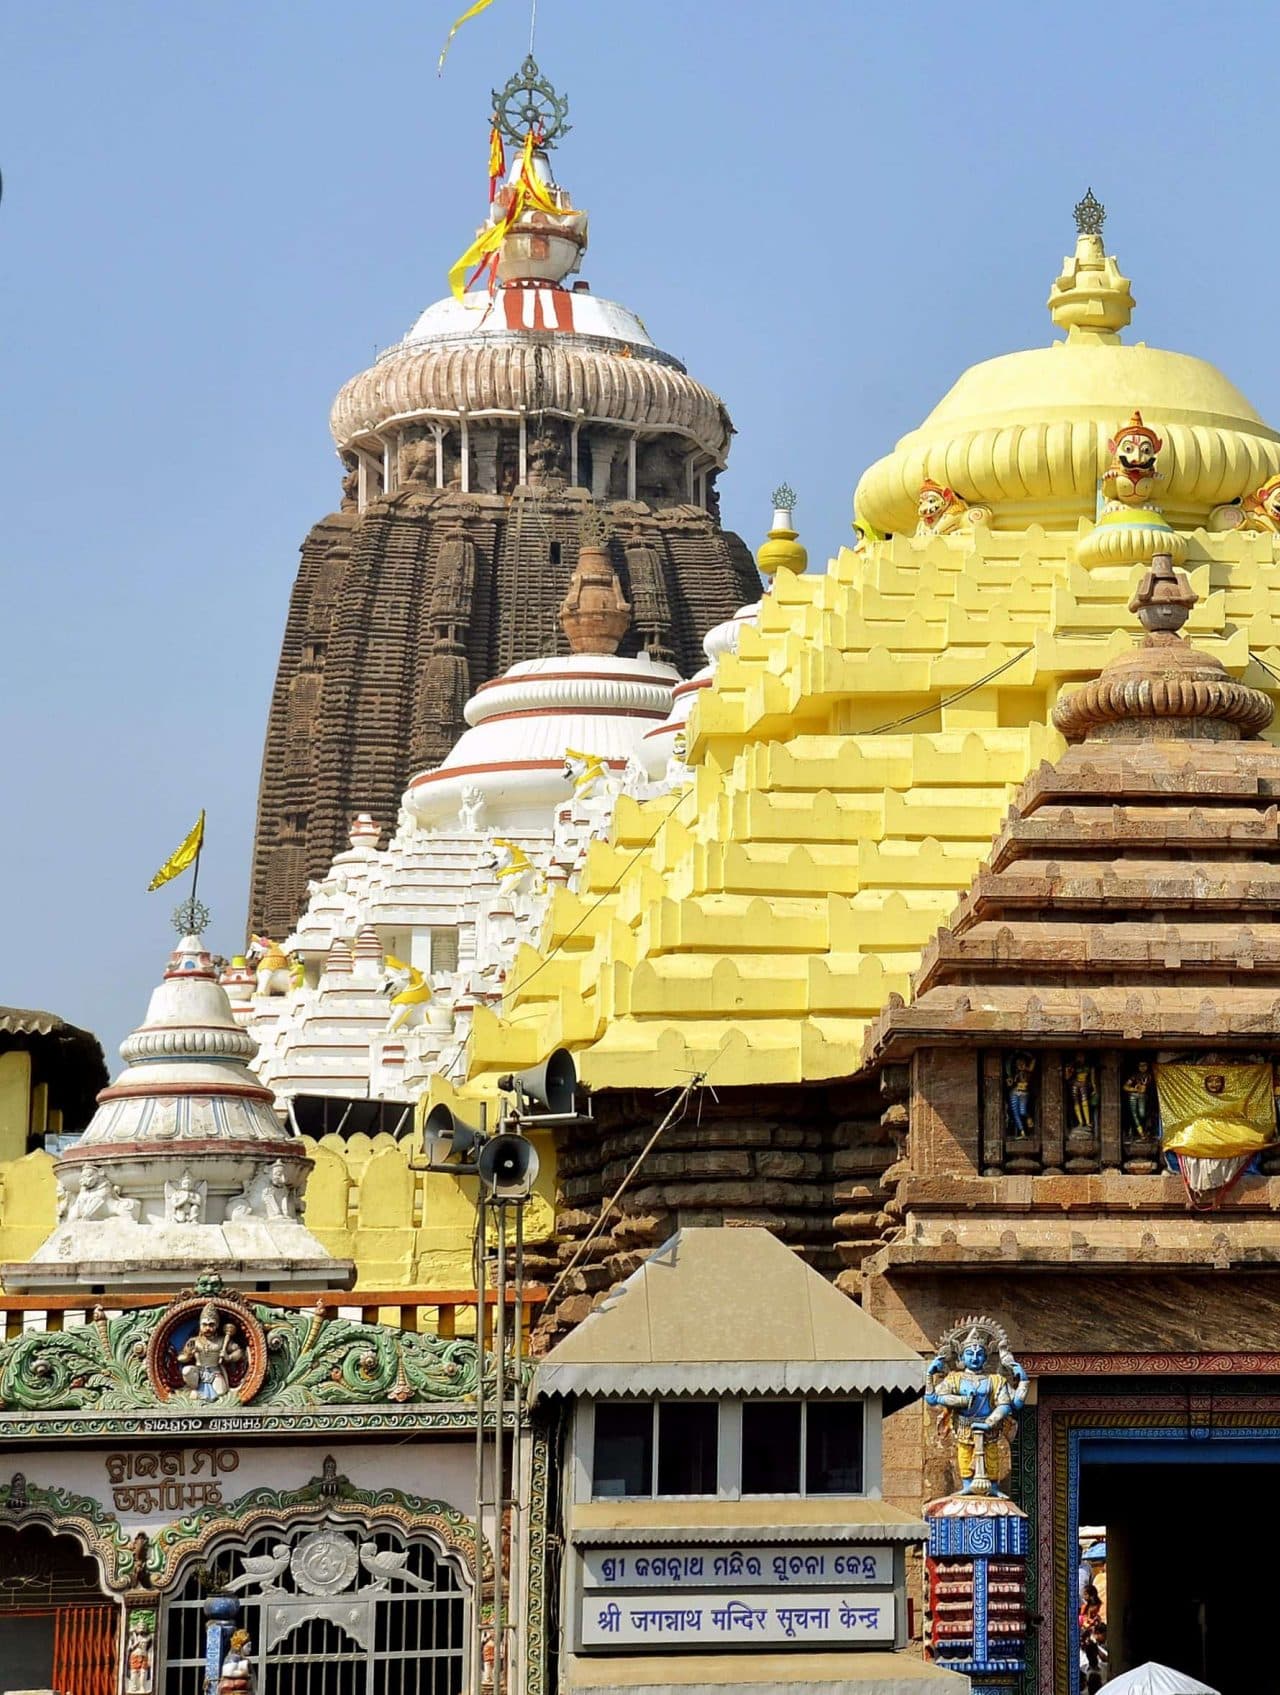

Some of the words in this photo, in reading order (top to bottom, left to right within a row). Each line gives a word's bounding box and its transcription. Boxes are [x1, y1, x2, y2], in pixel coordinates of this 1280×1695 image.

[601, 1557, 625, 1581] ଶ୍ରୀ
[635, 1556, 703, 1581] ଜଗନ୍ନାଥ
[713, 1551, 762, 1577] ମନ୍ଦିର
[772, 1555, 824, 1581] ସୂଚନା
[834, 1555, 877, 1580] କେନ୍ଦ୍ର
[598, 1602, 622, 1633] श्री
[630, 1609, 703, 1632] जगन्नाथ
[711, 1600, 768, 1631] मन्दिर
[776, 1608, 831, 1638] सूचना
[839, 1599, 881, 1630] केन्द्र
